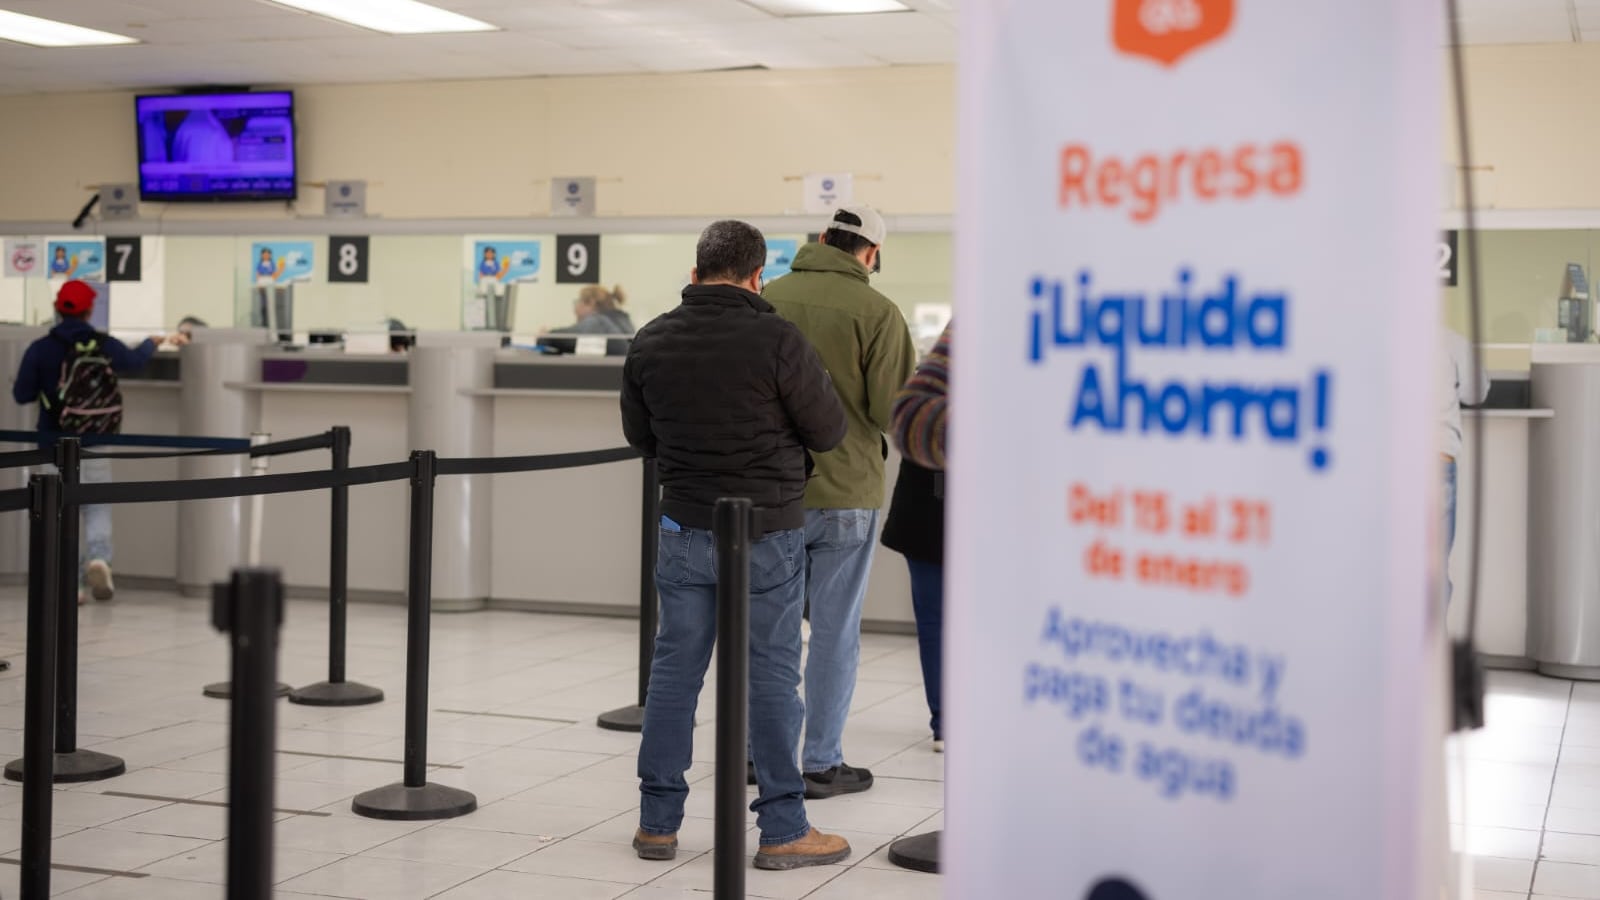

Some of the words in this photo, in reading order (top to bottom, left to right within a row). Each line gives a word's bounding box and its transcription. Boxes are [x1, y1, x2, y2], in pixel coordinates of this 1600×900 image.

[1058, 140, 1306, 224] Regresa
[115, 243, 132, 275] 7
[338, 243, 358, 276] 8
[567, 242, 588, 277] 9
[1028, 268, 1289, 368] ¡Liquida
[1068, 364, 1333, 472] Ahorra!
[1069, 483, 1122, 528] Del
[1131, 490, 1171, 536] 15
[1181, 494, 1217, 538] al
[1085, 537, 1125, 578] de
[1135, 554, 1249, 597] enero
[1042, 607, 1249, 683] Aprovecha
[1258, 654, 1285, 701] y
[1024, 661, 1110, 719] paga
[1117, 679, 1163, 722] tu
[1174, 684, 1307, 758] deuda
[1077, 722, 1125, 770] de
[1135, 738, 1237, 801] agua
